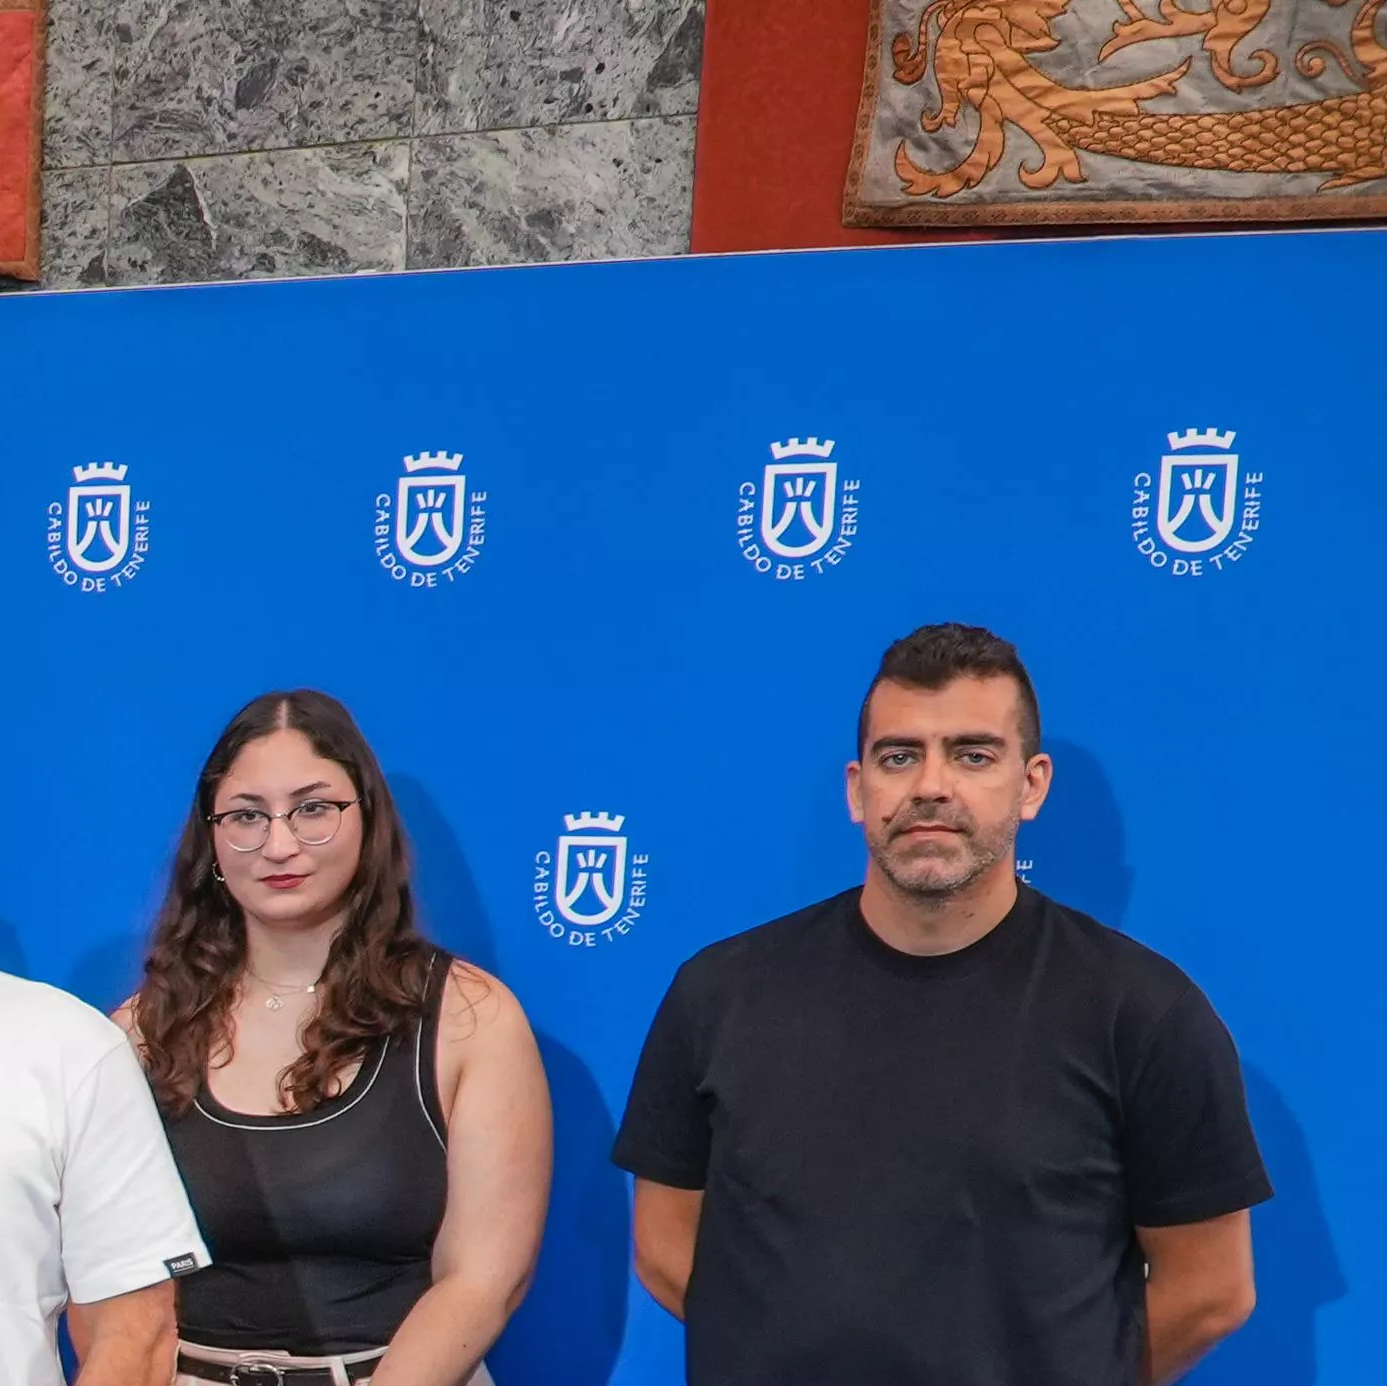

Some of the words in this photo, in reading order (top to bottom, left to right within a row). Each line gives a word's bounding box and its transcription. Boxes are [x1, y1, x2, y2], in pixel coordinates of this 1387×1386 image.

[48, 502, 78, 585] CABILDO
[81, 578, 106, 592] DE
[111, 501, 150, 587] TENERIFE
[375, 493, 406, 580] CABILDO
[411, 572, 437, 587] DE
[442, 491, 487, 581] TENERIFE
[737, 482, 772, 572] CABILDO
[776, 564, 805, 580] DE
[811, 480, 860, 573] TENERIFE
[1132, 472, 1167, 567] CABILDO
[1172, 559, 1203, 576] DE
[1209, 472, 1263, 570] TENERIFE
[534, 851, 565, 937] CABILDO
[569, 931, 596, 946] DE
[602, 854, 649, 942] TENERIFE
